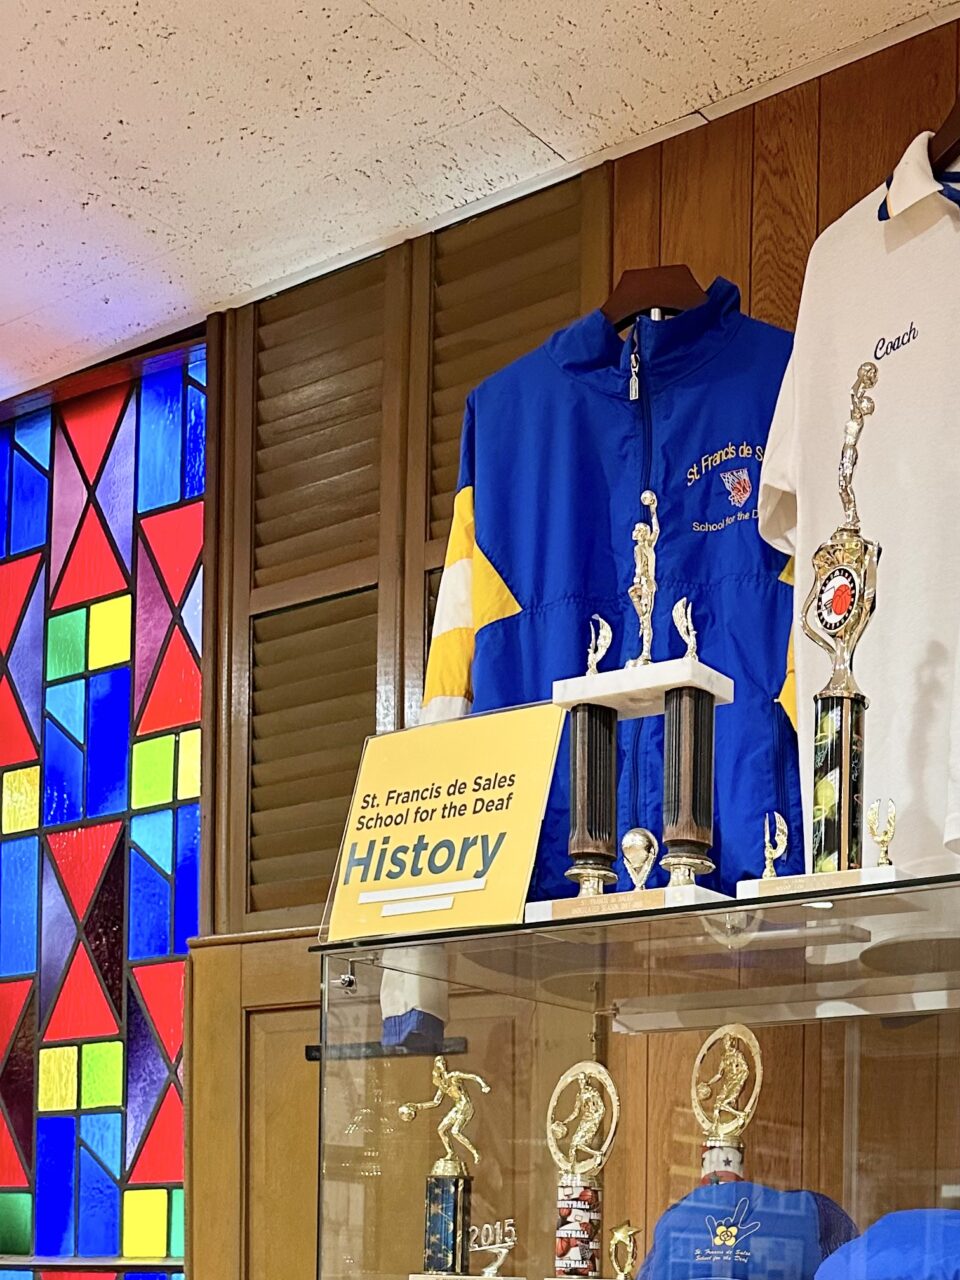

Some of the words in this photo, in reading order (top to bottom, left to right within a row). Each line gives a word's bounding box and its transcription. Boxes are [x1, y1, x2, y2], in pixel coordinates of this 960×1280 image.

[874, 322, 919, 360] Coach
[687, 464, 700, 486] St
[701, 442, 736, 474] Francis
[739, 441, 752, 457] de
[693, 520, 725, 531] School
[726, 515, 735, 525] for
[737, 512, 749, 520] the
[361, 794, 379, 809] St.
[385, 783, 441, 806] Francis
[447, 779, 466, 796] de
[472, 773, 515, 792] Sales
[356, 809, 409, 830] School
[414, 806, 437, 823] for
[441, 802, 466, 819] the
[473, 793, 513, 815] Deaf
[343, 832, 507, 885] History
[468, 1219, 517, 1250] 2015
